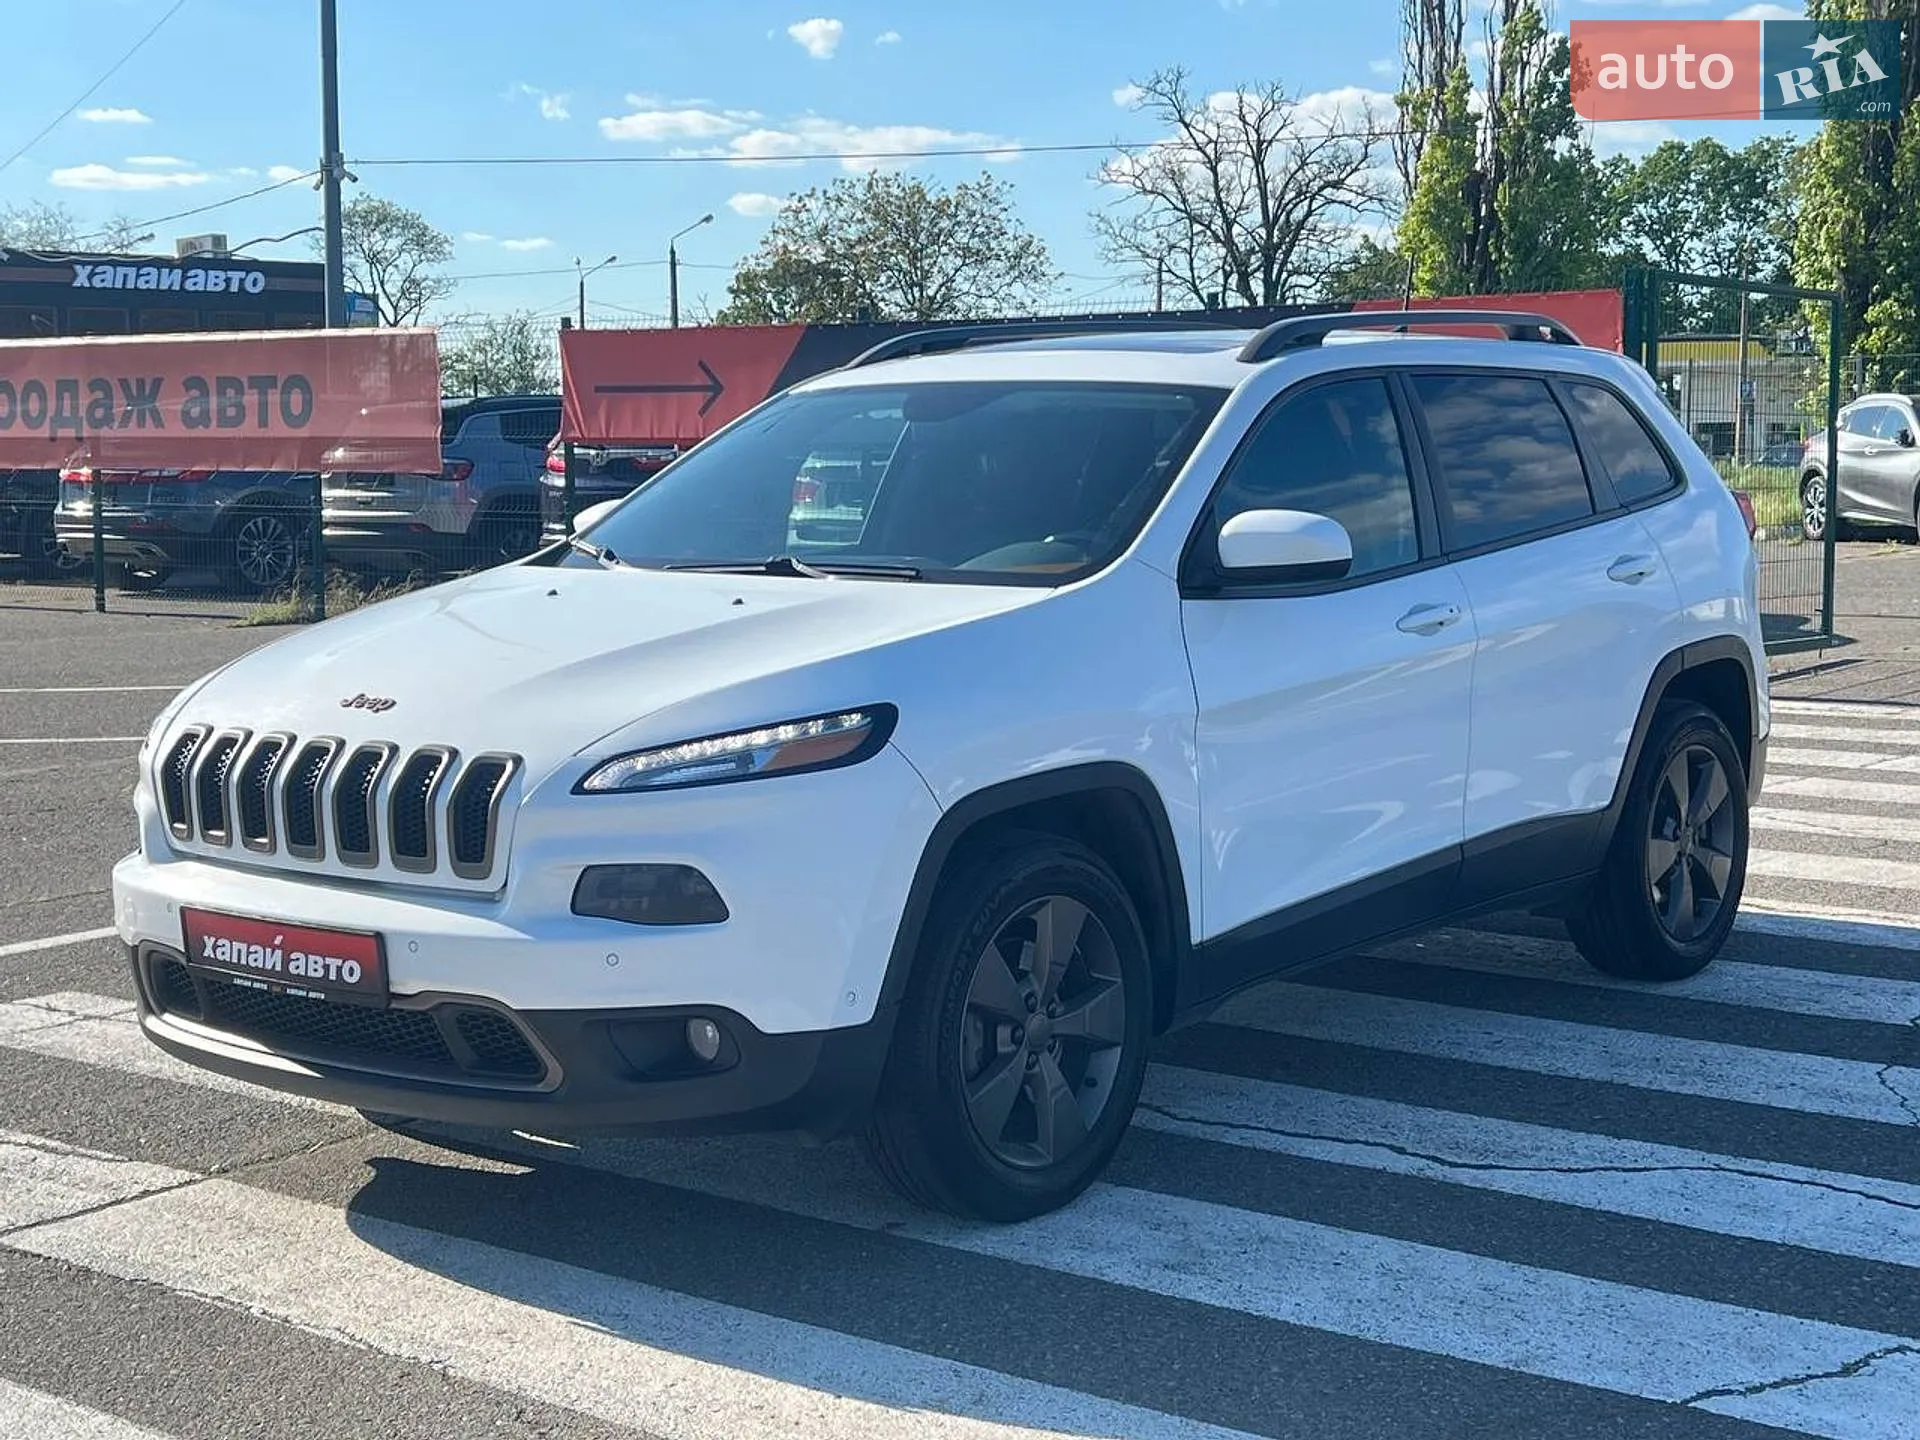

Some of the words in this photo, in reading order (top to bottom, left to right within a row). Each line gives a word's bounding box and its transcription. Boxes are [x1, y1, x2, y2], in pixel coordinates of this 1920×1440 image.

[181, 374, 314, 430] авто
[339, 692, 397, 714] Jeep
[202, 934, 283, 972] хапай
[288, 951, 362, 985] авто
